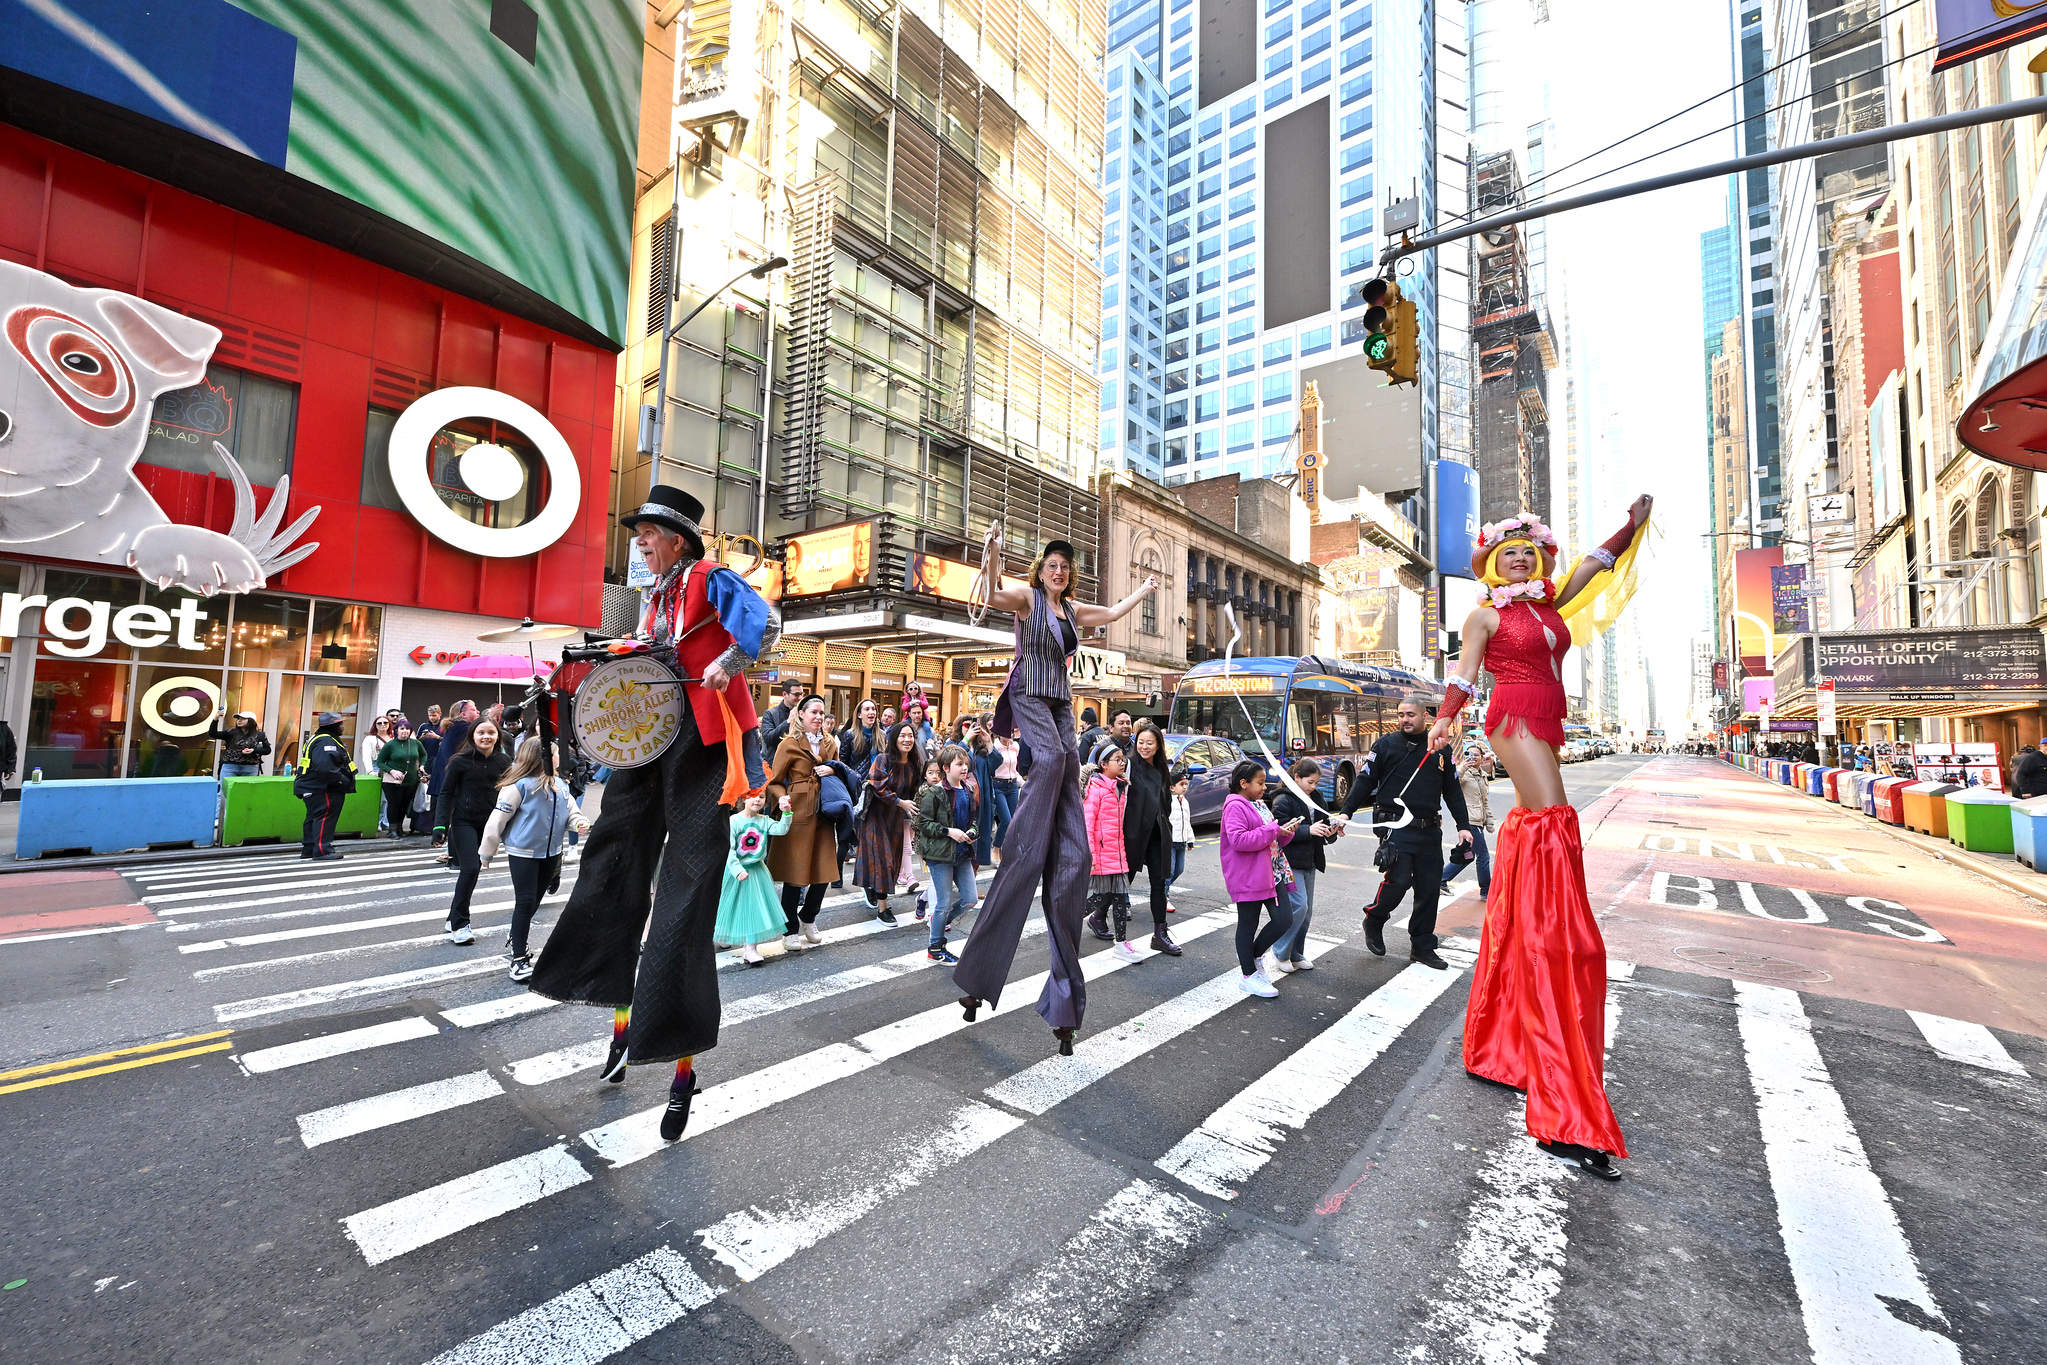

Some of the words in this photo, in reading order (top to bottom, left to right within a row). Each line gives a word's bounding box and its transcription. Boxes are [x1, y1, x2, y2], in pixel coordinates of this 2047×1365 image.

[1306, 412, 1314, 447] THEATRE
[803, 546, 850, 572] DOUBT
[915, 619, 934, 627] DOUBT
[1427, 590, 1437, 632] VICTORY
[1427, 637, 1438, 657] NEW
[1892, 641, 1957, 653] OFFICE
[1963, 648, 2040, 658] 212-372-2430
[1071, 650, 1108, 680] NY
[1819, 654, 1939, 667] OPPORTUNITY
[1213, 677, 1273, 692] CROSSTOWN
[1962, 672, 2039, 680] 212-372-2299
[582, 697, 594, 714] The
[617, 667, 634, 676] The
[584, 702, 642, 735] SHINBONE
[644, 688, 675, 711] ALLEY
[596, 741, 637, 761] STILT
[640, 713, 676, 756] BAND
[1649, 870, 1949, 944] BUS
